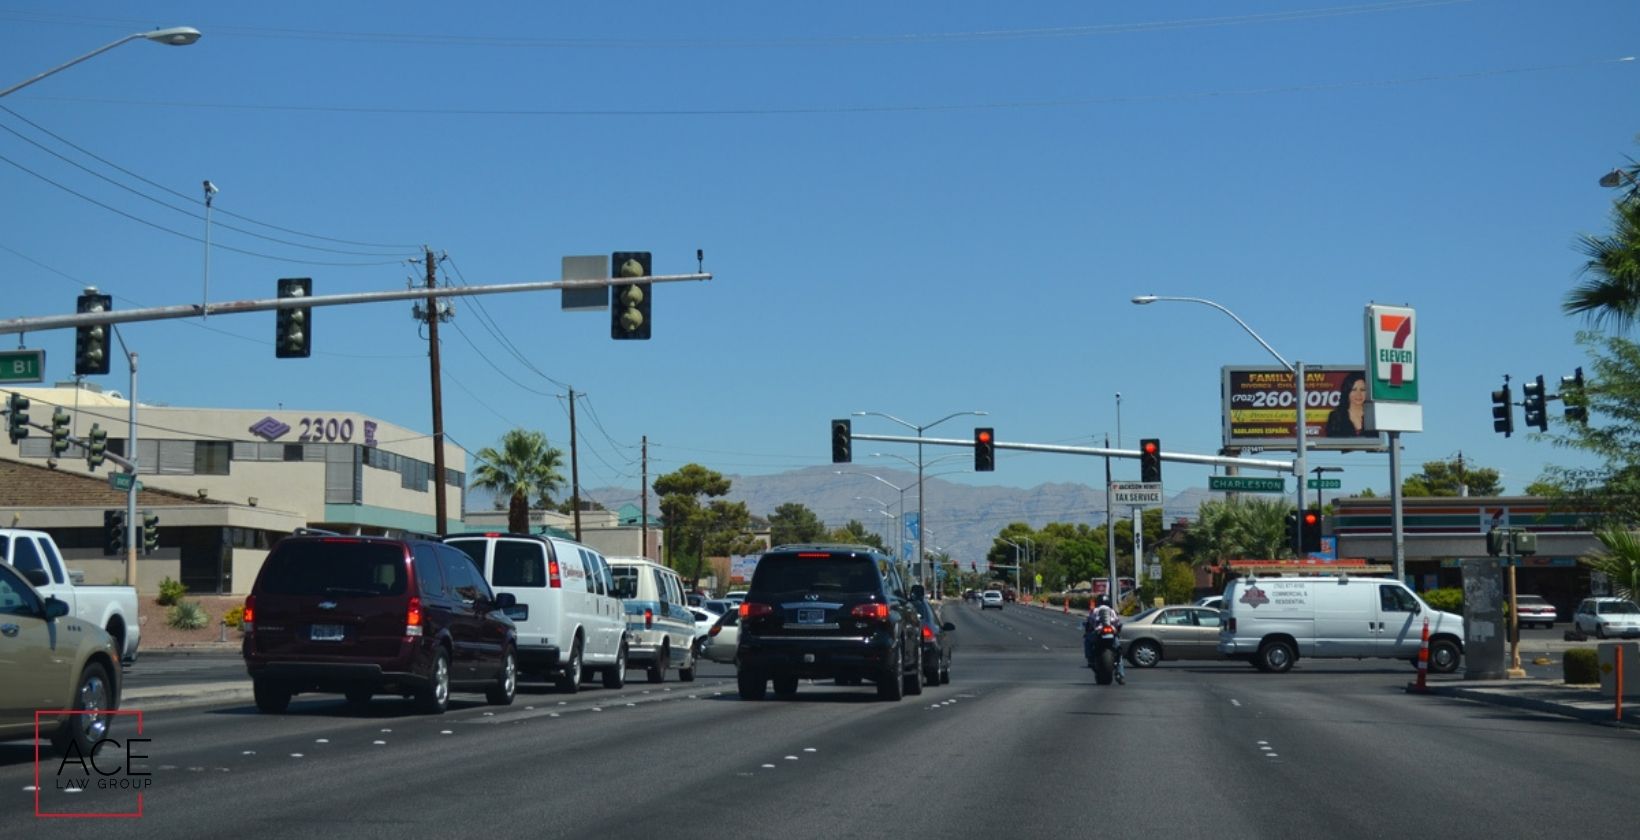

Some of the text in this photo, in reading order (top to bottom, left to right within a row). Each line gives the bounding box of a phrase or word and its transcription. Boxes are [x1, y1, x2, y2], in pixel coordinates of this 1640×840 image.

[1380, 314, 1411, 386] 7
[1249, 373, 1294, 382] FAMILY
[1232, 394, 1255, 402] (702)
[299, 418, 354, 441] 2300
[1213, 480, 1281, 489] CHARLESTON
[1115, 493, 1159, 501] TAX SERVICE
